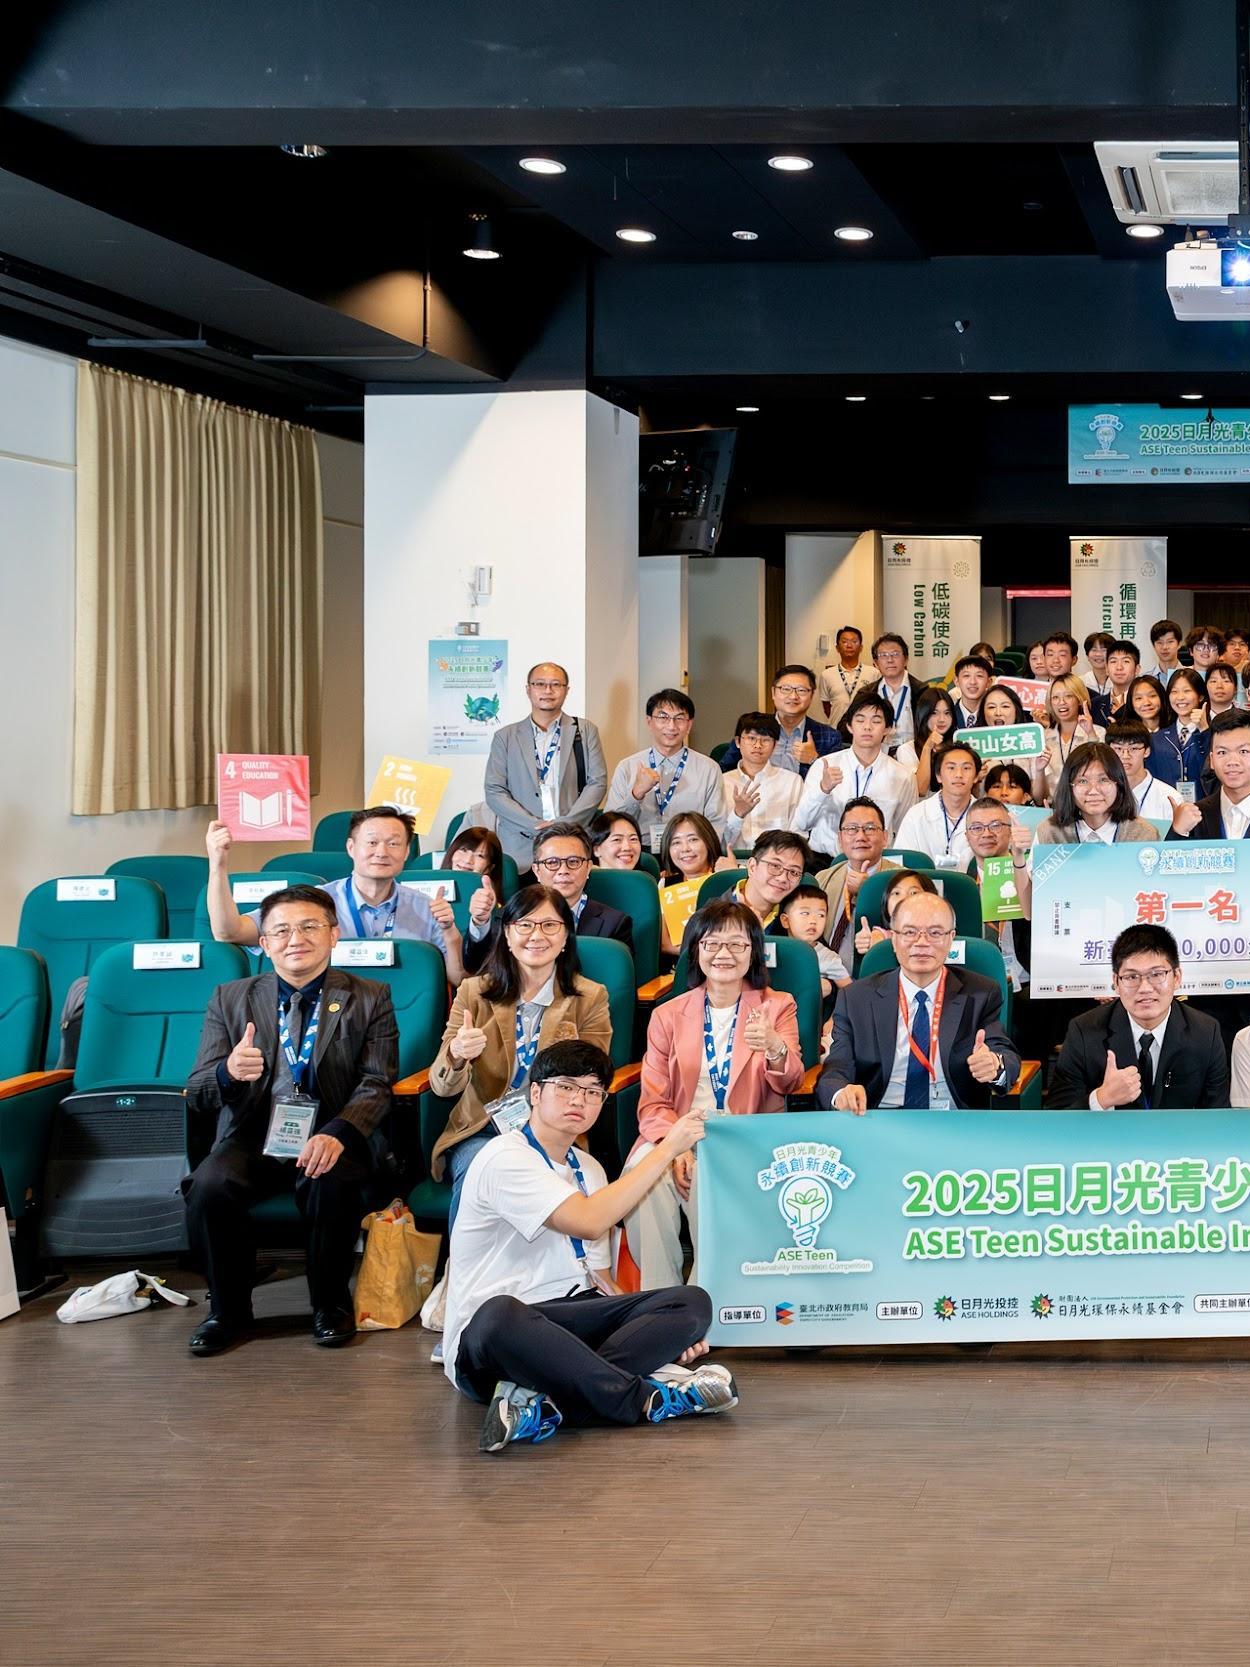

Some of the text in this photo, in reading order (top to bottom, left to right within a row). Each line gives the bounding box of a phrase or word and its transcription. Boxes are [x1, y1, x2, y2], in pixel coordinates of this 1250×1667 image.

[1141, 444, 1160, 454] ASE
[1163, 444, 1188, 454] Teen
[1190, 443, 1250, 454] Sustainable
[1102, 595, 1114, 634] Circul
[1119, 583, 1137, 639] 循環再
[931, 582, 950, 659] 低碳使命
[914, 612, 926, 657] Carbon
[224, 761, 237, 779] 4
[241, 761, 270, 769] QUALITY
[383, 761, 395, 777] 2
[242, 771, 279, 780] EDUCATION
[986, 861, 1001, 876] 15
[1035, 846, 1071, 881] BANK
[664, 890, 674, 905] 2
[1134, 889, 1238, 924] 第一名
[775, 1145, 838, 1160] 日月光青少年
[759, 1156, 852, 1187] 永續創新競賽
[905, 1231, 961, 1256] ASE
[969, 1229, 1039, 1254] Teen
[1048, 1223, 1222, 1252] Sustainable
[778, 1250, 834, 1261] ASE Teen
[799, 1303, 869, 1313] 臺北市政府教育局
[961, 1297, 1018, 1310] 日月光投控
[1058, 1301, 1185, 1317] 日月光環保永續基金會
[723, 1310, 762, 1321] 指導單位
[881, 1306, 918, 1317] 主辦單位
[961, 1310, 1019, 1319] ASE HOLDINGS
